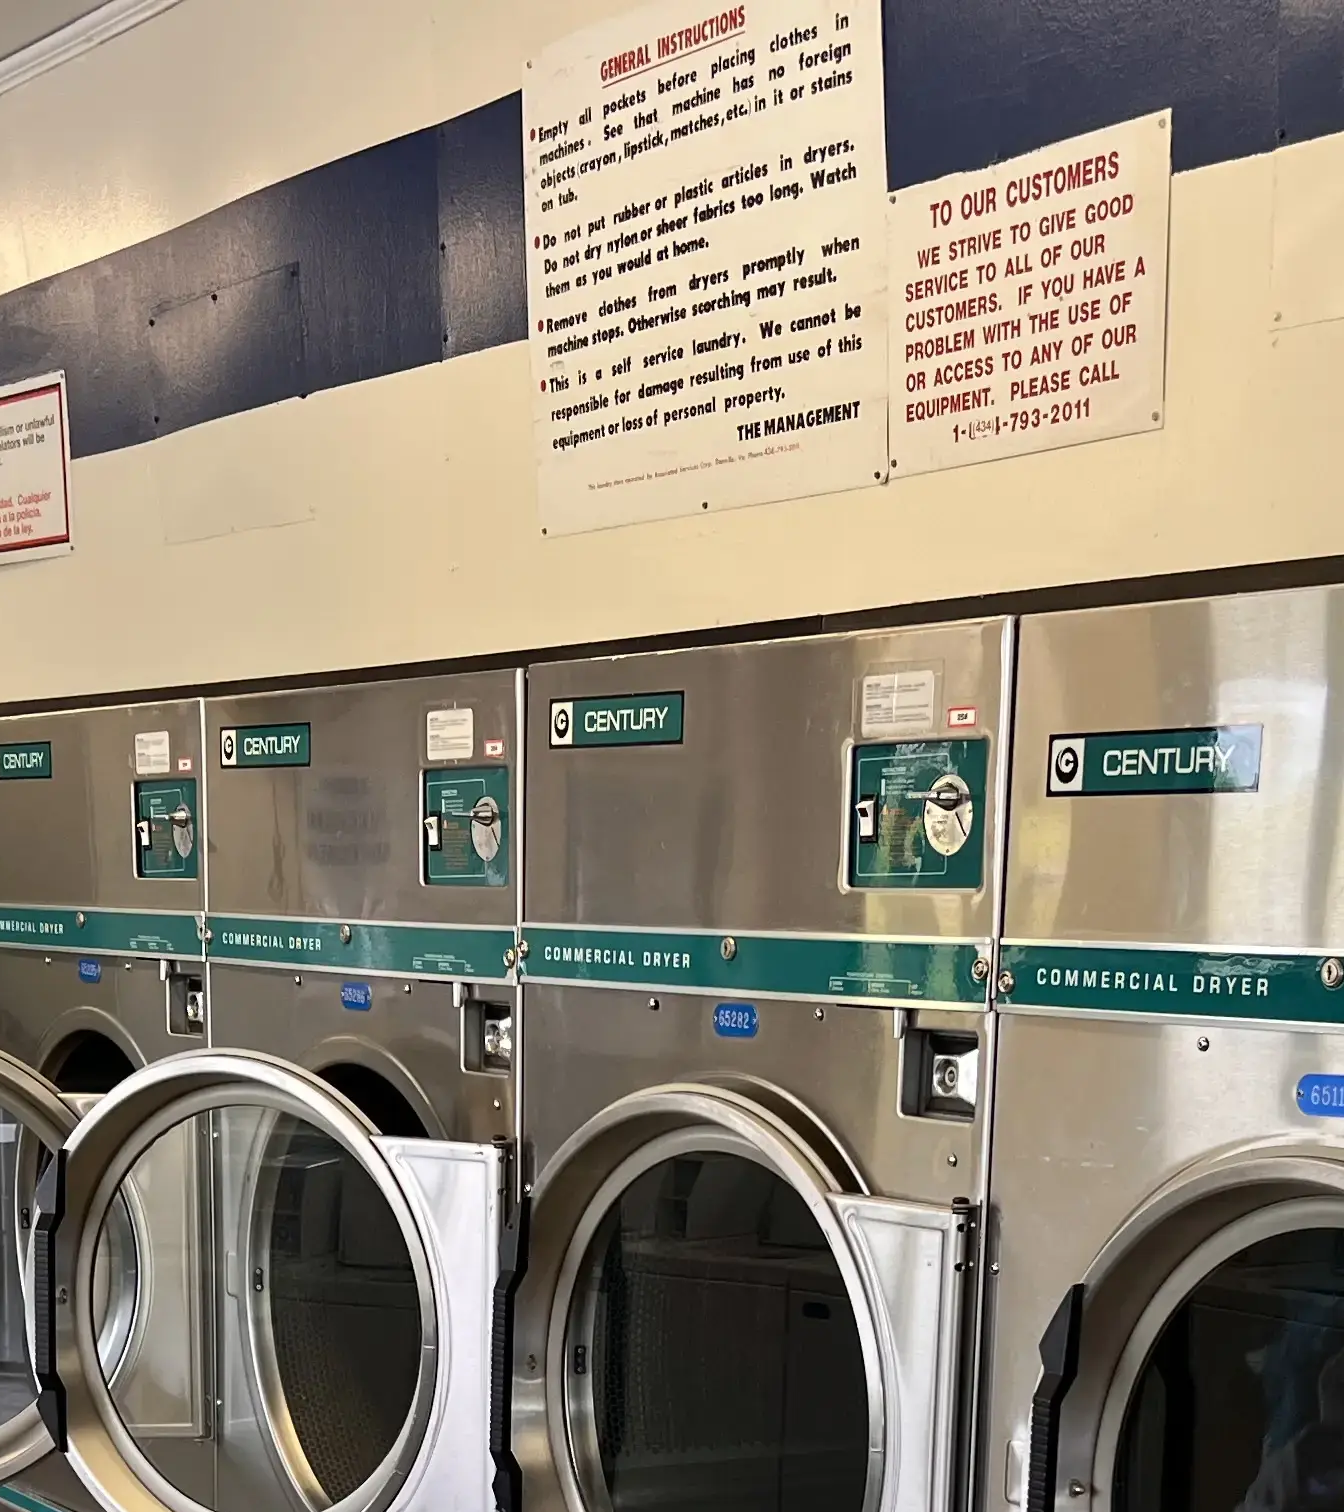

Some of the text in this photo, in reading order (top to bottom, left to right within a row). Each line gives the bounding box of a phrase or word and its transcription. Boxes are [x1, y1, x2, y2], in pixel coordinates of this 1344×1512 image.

[538, 12, 849, 144] Empty all pockets before placing clothes in
[600, 4, 745, 82] GENERAL INSTRUCTIONS
[603, 123, 623, 141] See
[633, 108, 659, 130] that
[672, 87, 721, 116] machine
[732, 74, 754, 94] has
[768, 65, 785, 82] no
[798, 43, 851, 71] foreign
[540, 165, 576, 190] objects
[623, 130, 669, 161] lipstick,
[754, 95, 767, 113] in
[773, 89, 784, 106] it
[790, 84, 805, 101] or
[810, 69, 853, 95] stains
[541, 187, 578, 213] on tub.
[542, 139, 855, 251] Do not put rubber or plastic articles in dryers.
[930, 151, 1119, 229] TO OUR CUSTOMERS
[917, 194, 1134, 269] WE STRIVE TO GIVE GOOD
[546, 237, 860, 335] Remove clothes from dryers promptly when
[905, 233, 1105, 303] SERVICE TO ALL OF OUR
[905, 256, 1146, 333] CUSTOMERS. IF YOU HAVE A
[549, 303, 861, 393] This is a self service laundry. We cannot be
[905, 291, 1133, 363] PROBLEM WITH THE USE OF
[906, 323, 1137, 393] OR ACCESS TO ANY OF OUR
[736, 400, 860, 442] THE MANAGEMENT
[906, 360, 1120, 423] EQUIPMENT. PLEASE CALL
[243, 735, 301, 756] CENTURY
[584, 707, 669, 733] CENTURY
[3, 752, 44, 769] CENTURY
[1103, 746, 1236, 778] CENTURY
[39, 922, 64, 935] DRYER
[222, 932, 322, 951] COMMERCIAL DRYER
[544, 947, 691, 969] COMMERCIAL DRYER
[1036, 967, 1270, 998] COMMERCIAL DRYER
[717, 1009, 751, 1030] 65282
